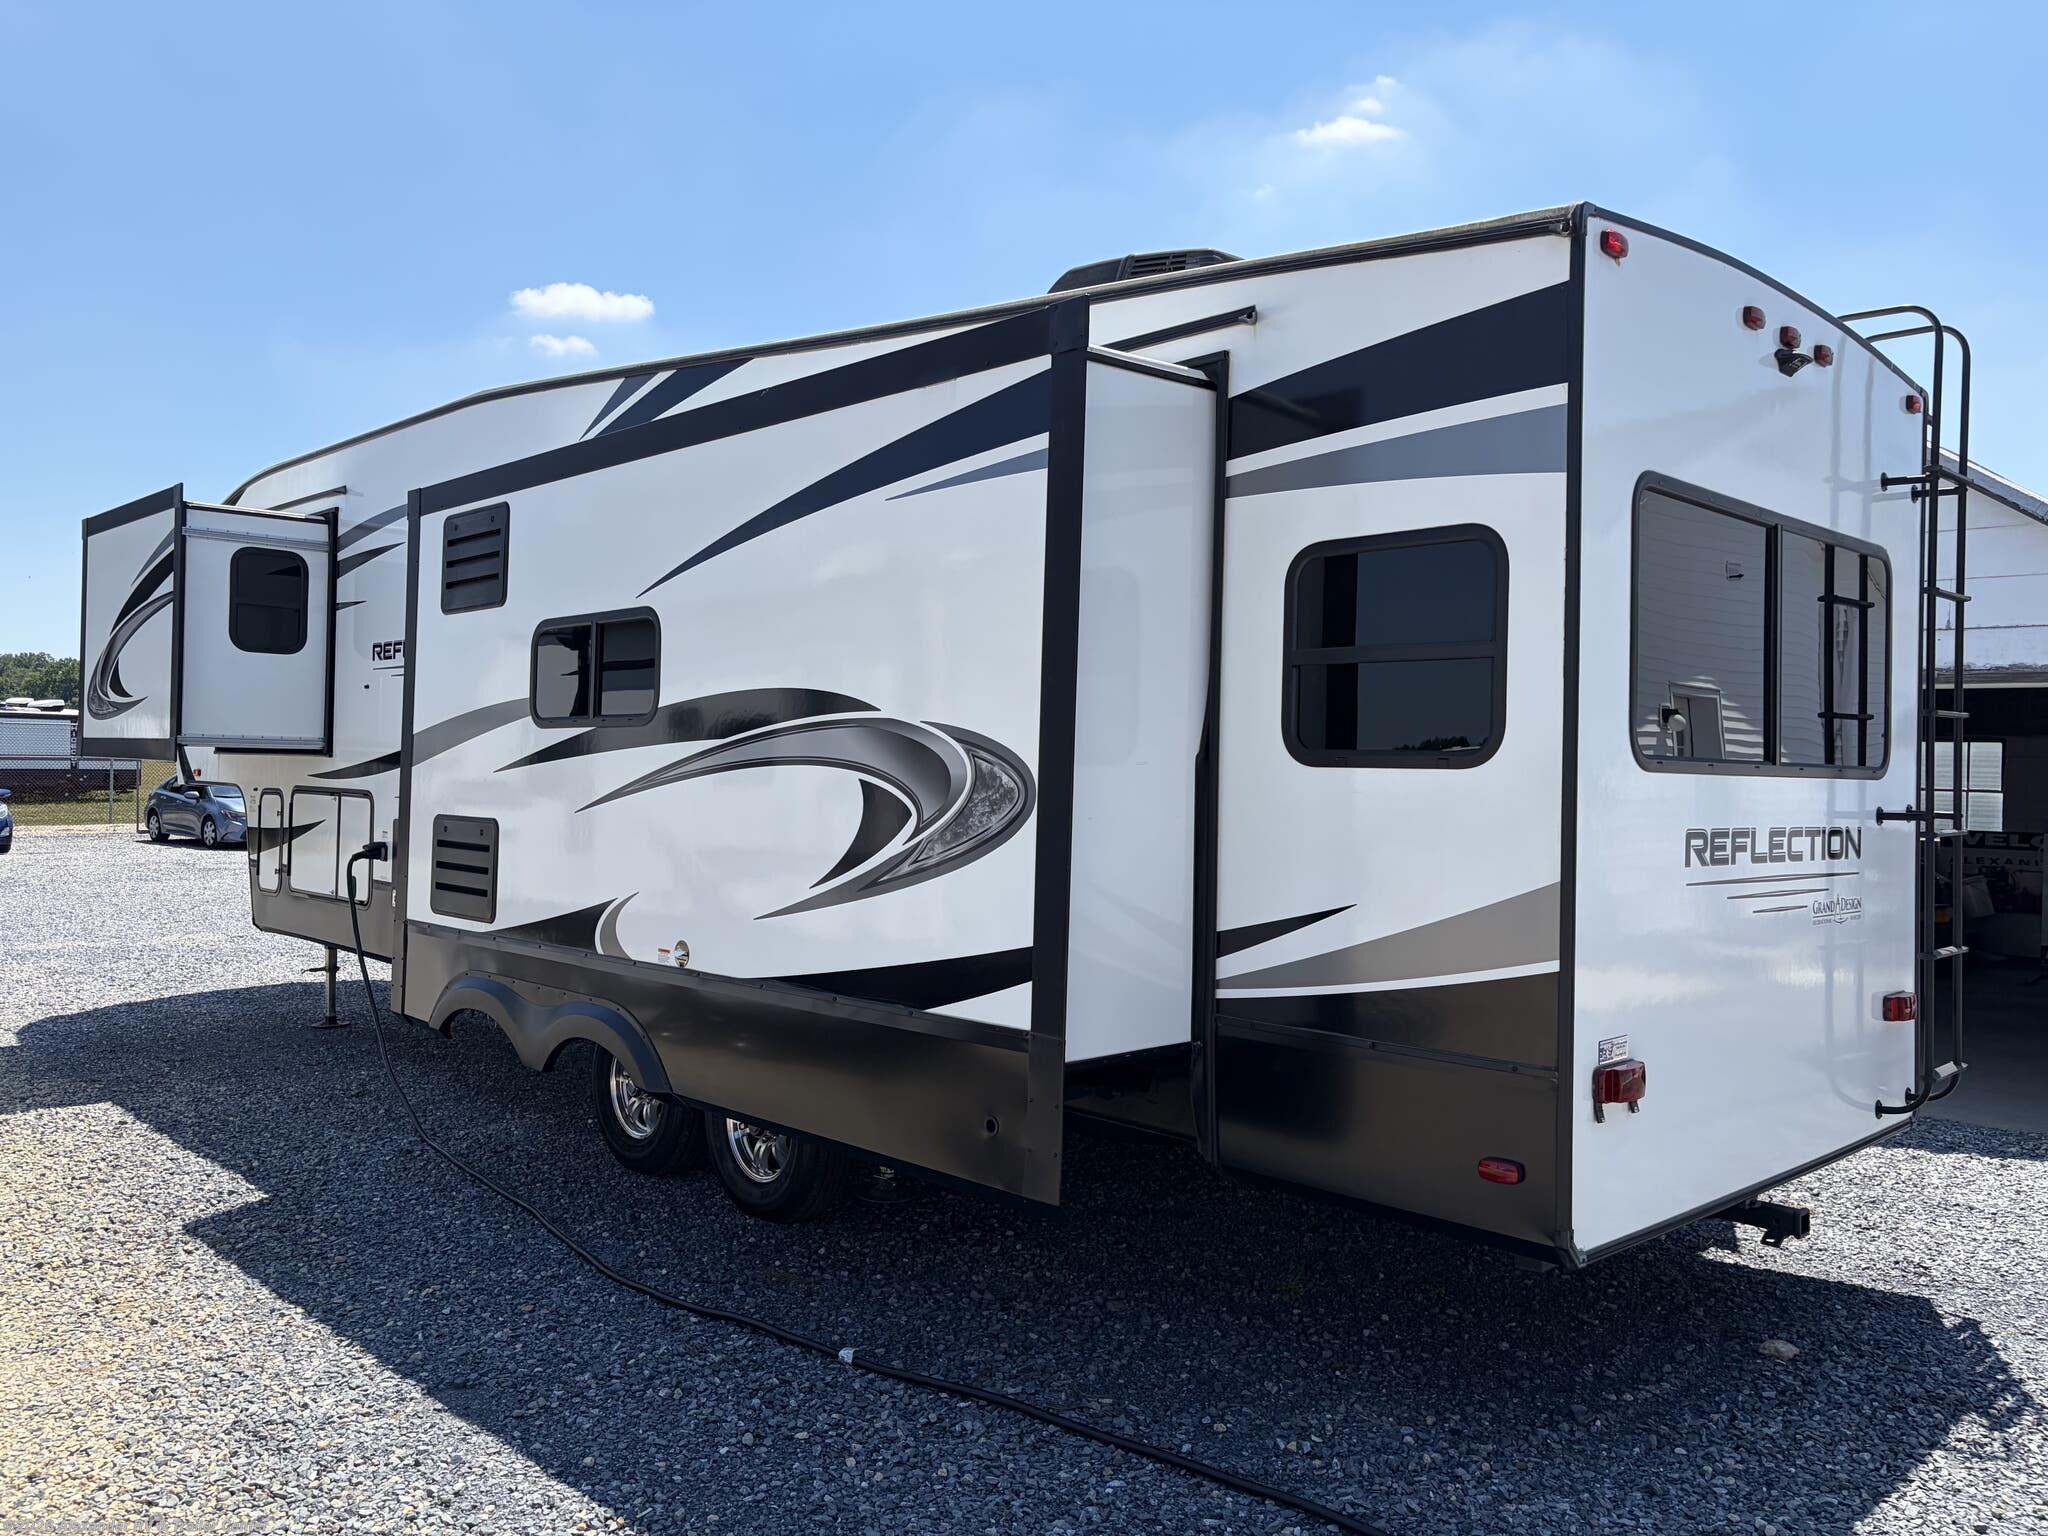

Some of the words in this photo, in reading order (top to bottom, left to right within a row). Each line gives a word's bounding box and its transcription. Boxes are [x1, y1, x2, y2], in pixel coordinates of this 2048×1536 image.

[1684, 826, 1862, 868] REFLECTION
[1950, 856, 2039, 866] LEXAN
[1812, 900, 1835, 915] GRAND
[1841, 897, 1862, 911] DESIGN
